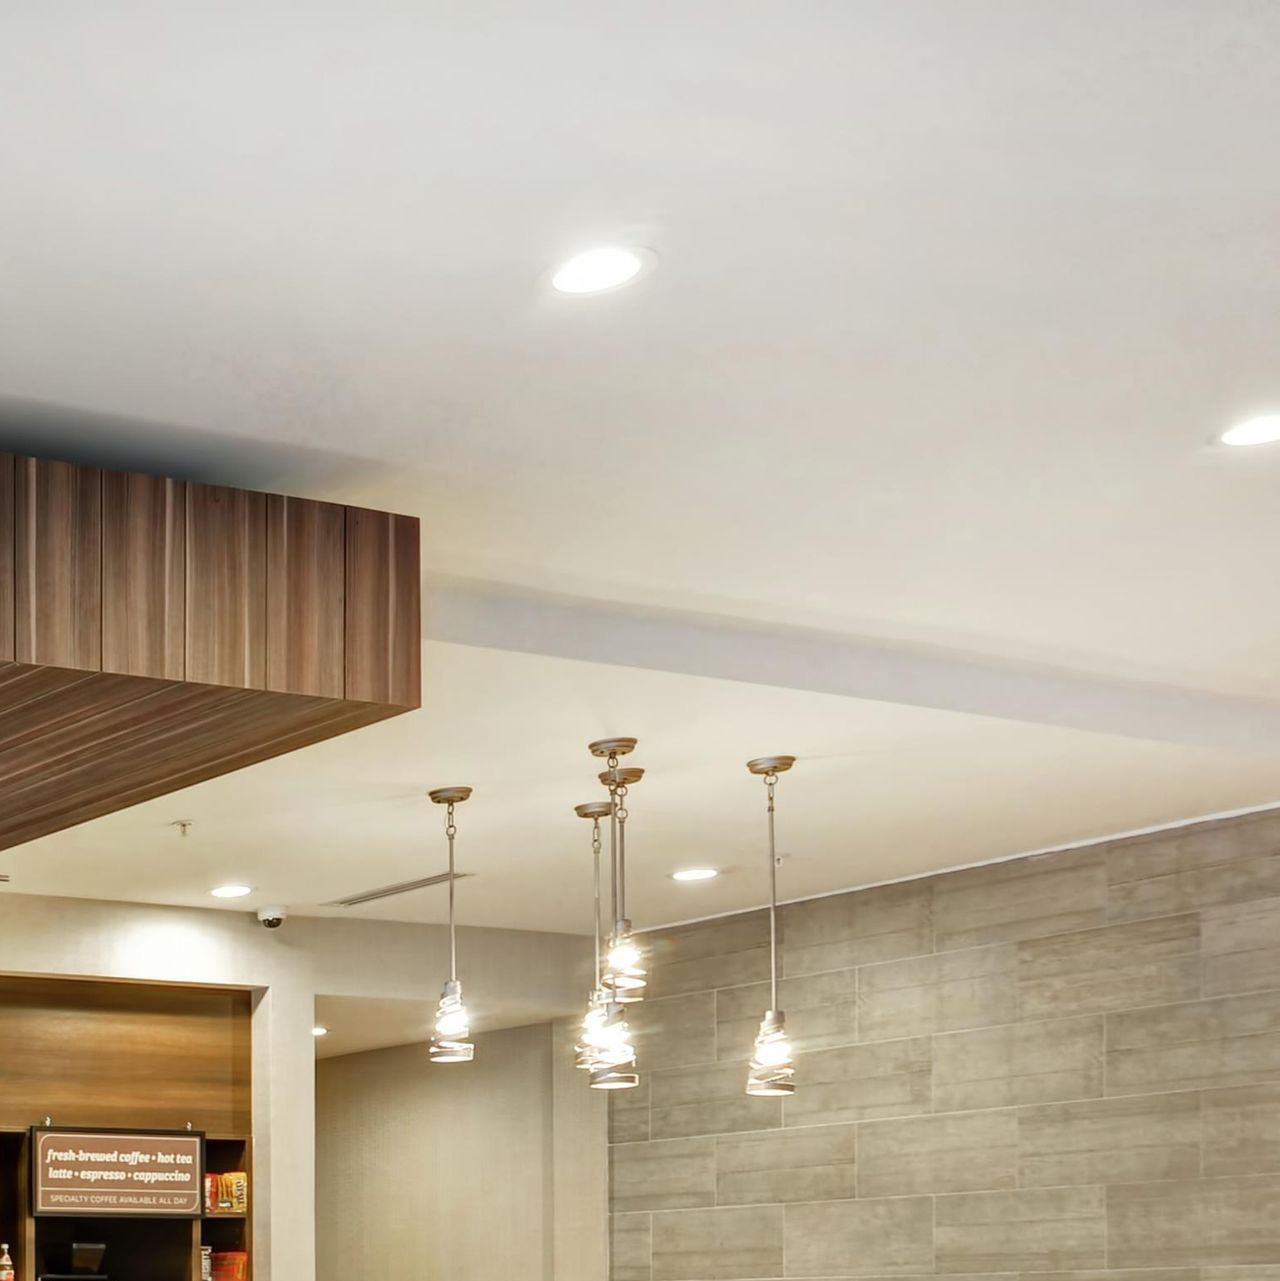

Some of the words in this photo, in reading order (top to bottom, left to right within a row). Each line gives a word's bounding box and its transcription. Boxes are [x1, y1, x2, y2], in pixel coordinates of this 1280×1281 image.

[46, 1149, 118, 1163] fresh-brewed
[119, 1152, 150, 1165] coffee
[157, 1153, 175, 1163] hot
[176, 1154, 192, 1164] tea
[48, 1168, 72, 1179] latte
[80, 1170, 125, 1182] espresso
[133, 1171, 190, 1183] cappuccino
[50, 1194, 89, 1203] SPECIALTY
[90, 1195, 118, 1204] COFFEE
[119, 1196, 157, 1205] AVAILABLE
[158, 1197, 172, 1205] ALL
[173, 1197, 187, 1205] DAY
